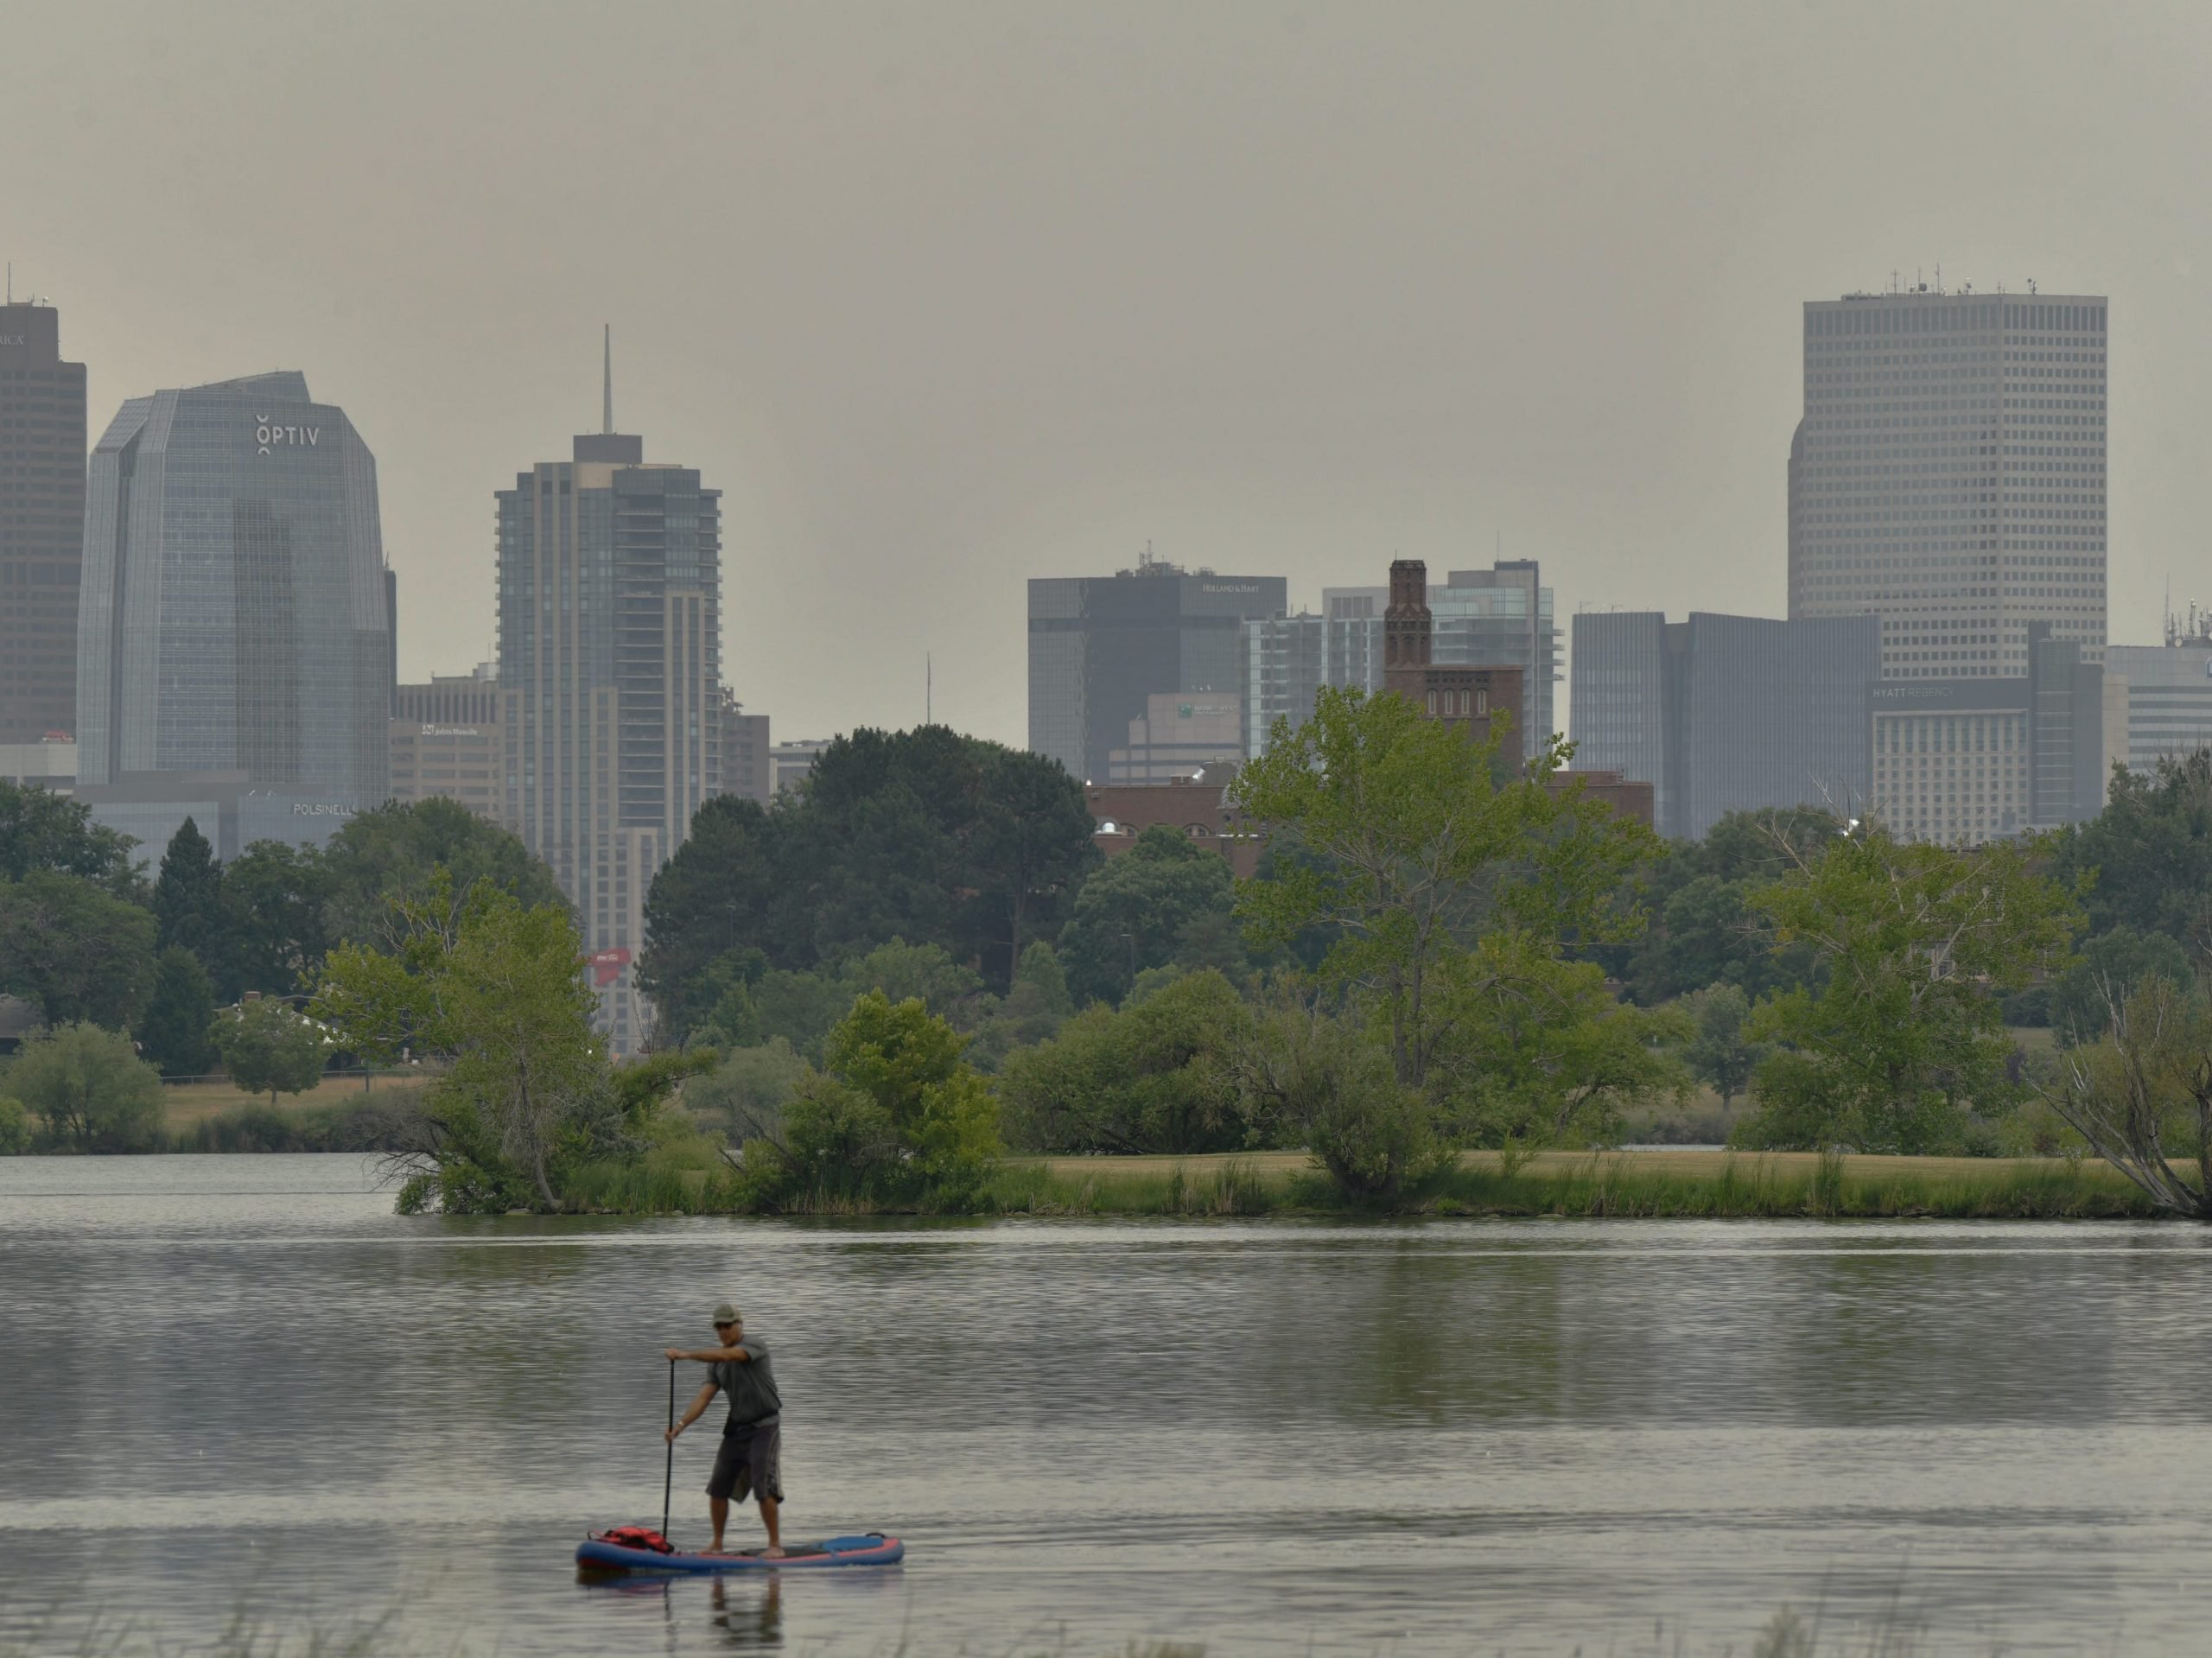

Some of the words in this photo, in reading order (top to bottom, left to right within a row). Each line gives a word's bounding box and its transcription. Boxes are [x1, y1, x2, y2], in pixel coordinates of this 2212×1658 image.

[256, 426, 319, 446] OPTIV
[1203, 583, 1234, 593] HOLLAND
[1242, 584, 1259, 593] HART
[1872, 688, 1906, 698] HYATT
[1908, 687, 1955, 697] REGENCY
